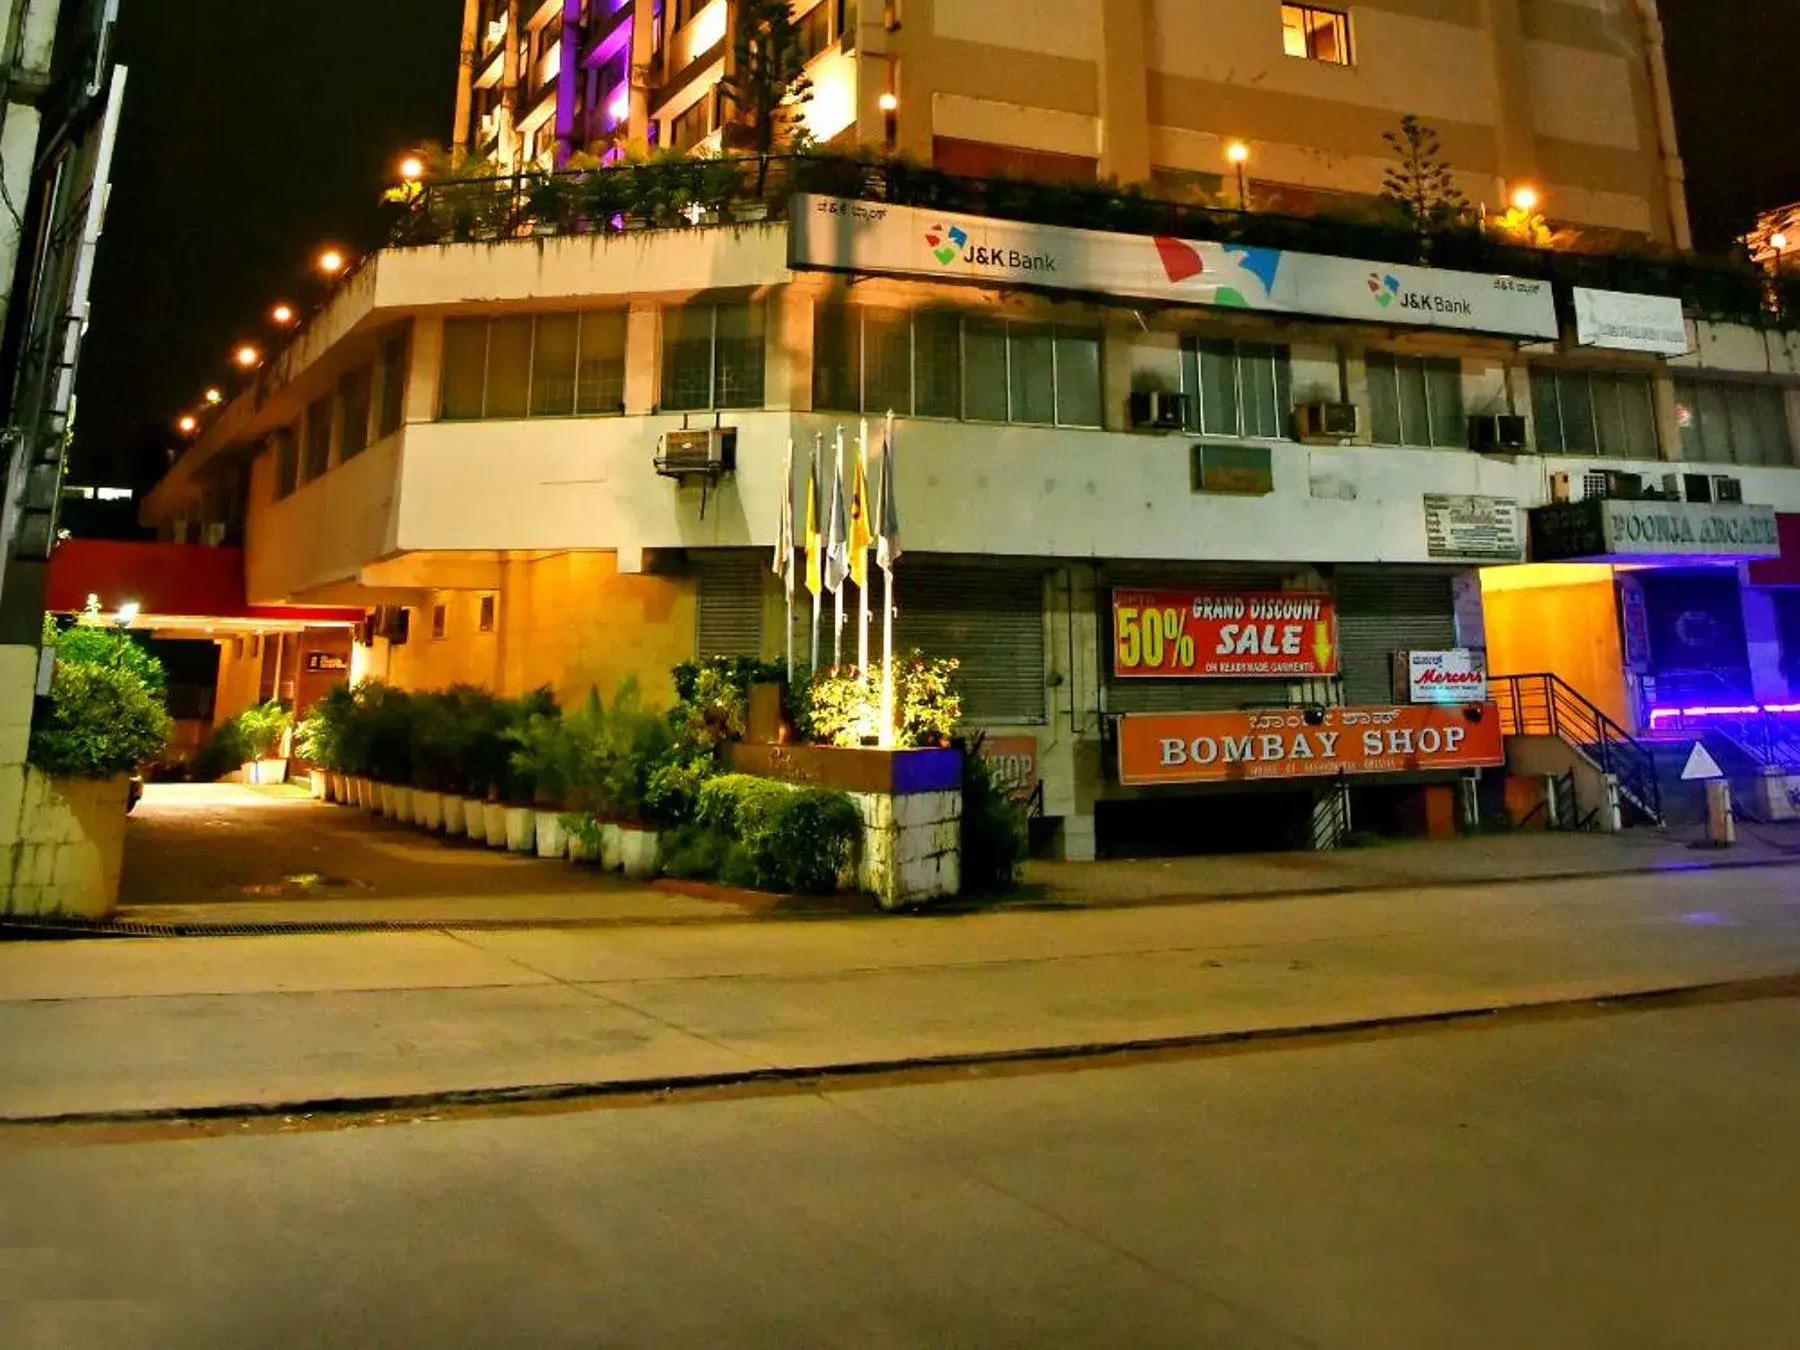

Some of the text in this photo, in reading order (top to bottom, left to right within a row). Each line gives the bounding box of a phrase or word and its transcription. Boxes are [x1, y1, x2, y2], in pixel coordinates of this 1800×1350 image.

[964, 246, 1055, 272] J&K Bank
[1401, 293, 1472, 315] J&K Bank
[1192, 597, 1322, 621] GRAND DISCOUNT
[1117, 607, 1195, 667] 50%
[1215, 623, 1304, 655] SALE
[1159, 725, 1465, 766] BOMBAY SHOP
